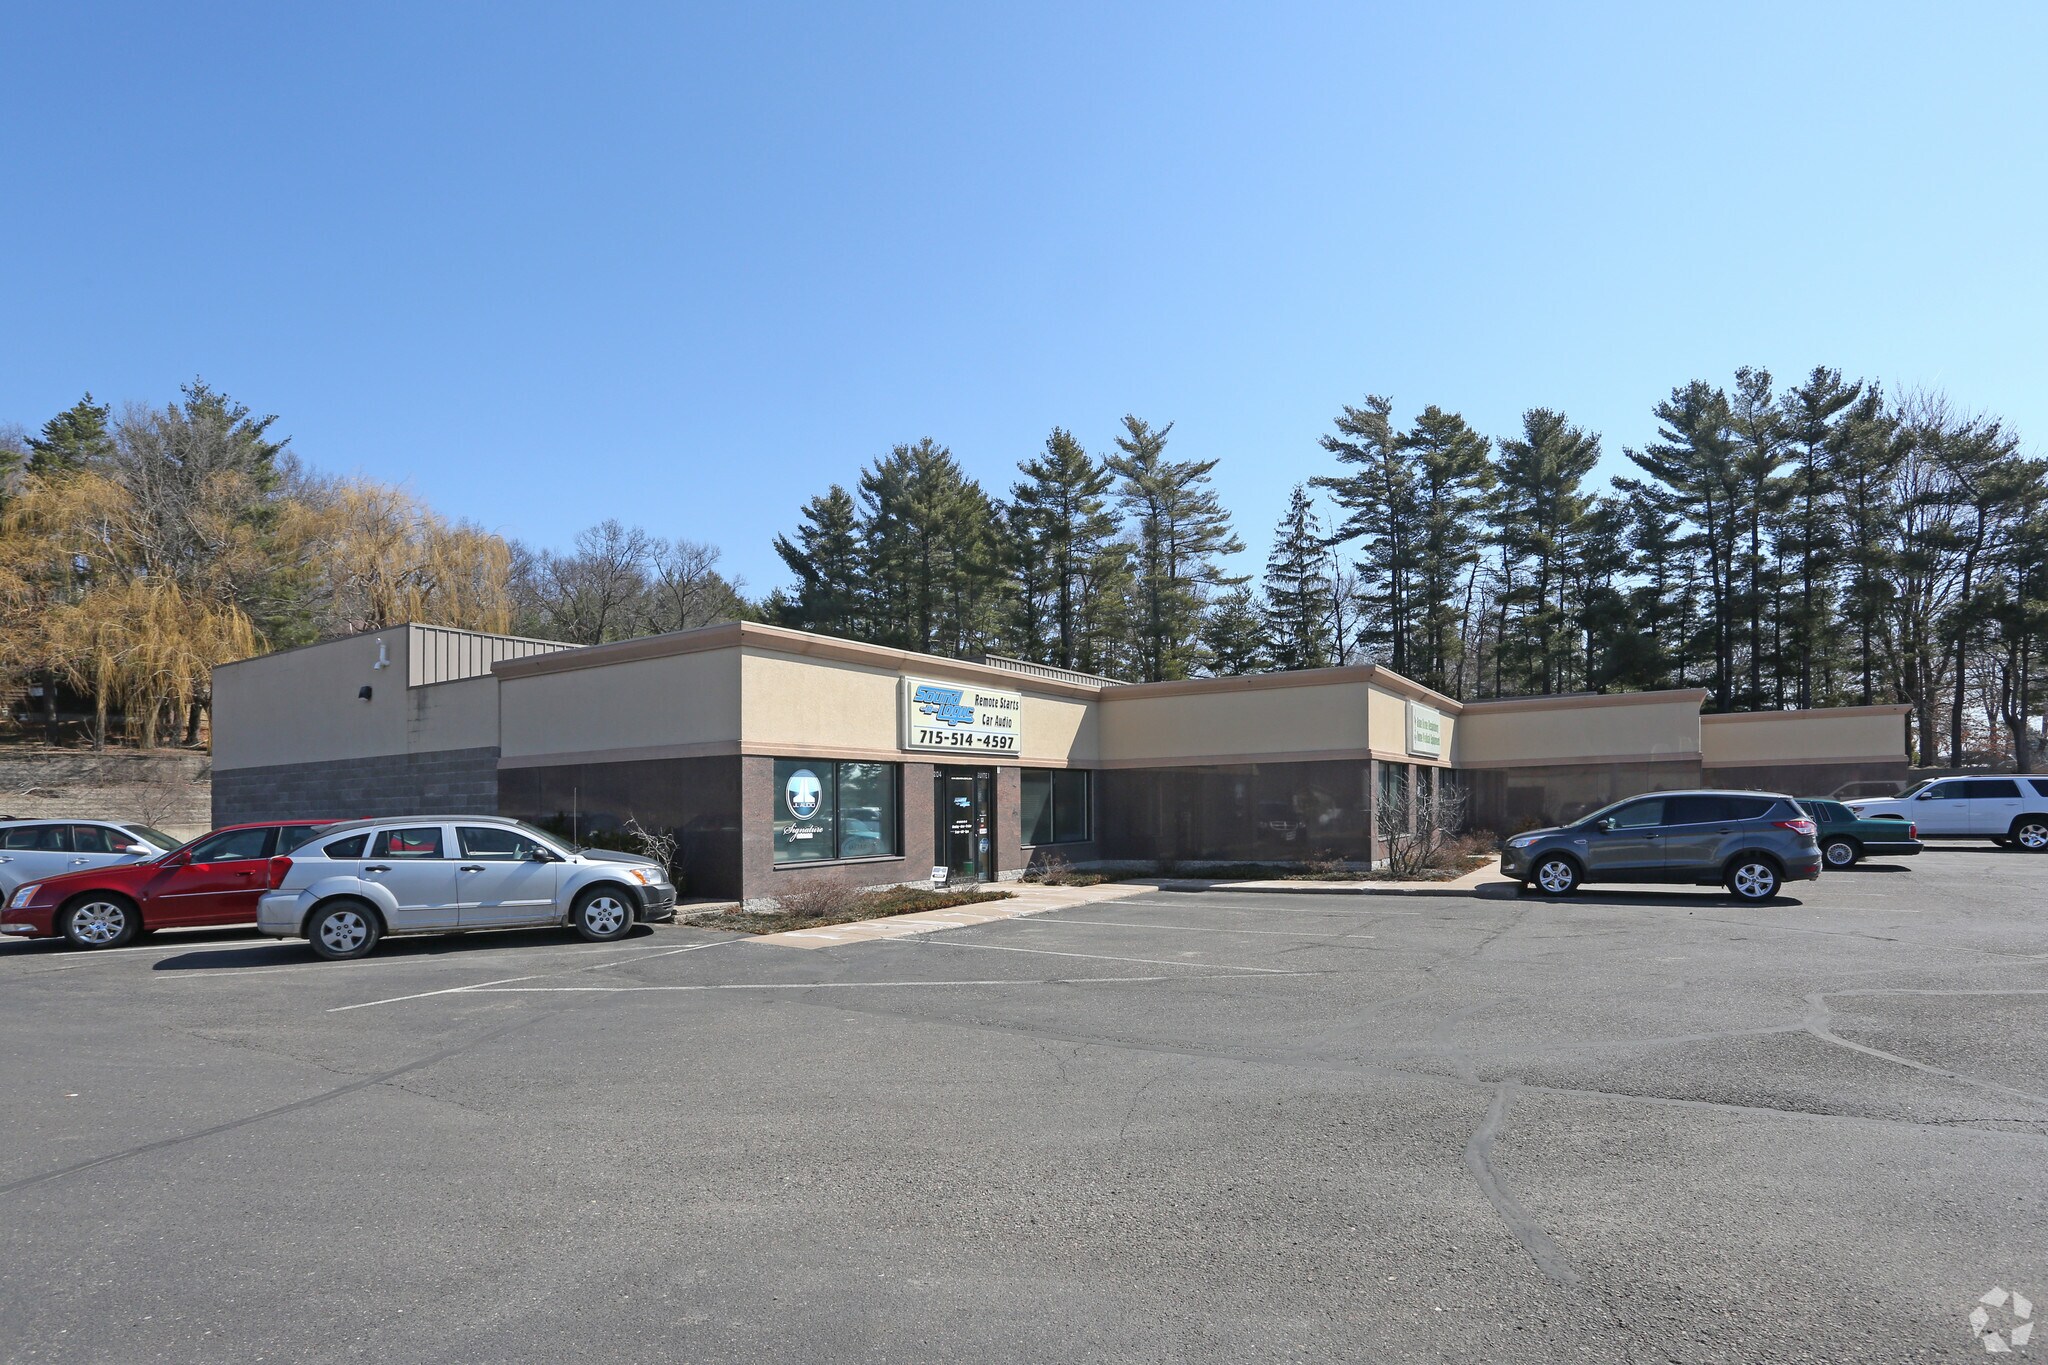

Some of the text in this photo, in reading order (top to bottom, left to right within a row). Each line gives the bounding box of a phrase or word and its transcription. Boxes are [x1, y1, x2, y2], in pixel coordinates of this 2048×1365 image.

[975, 694, 1019, 710] Remote Starts
[982, 714, 1012, 728] Car Audio
